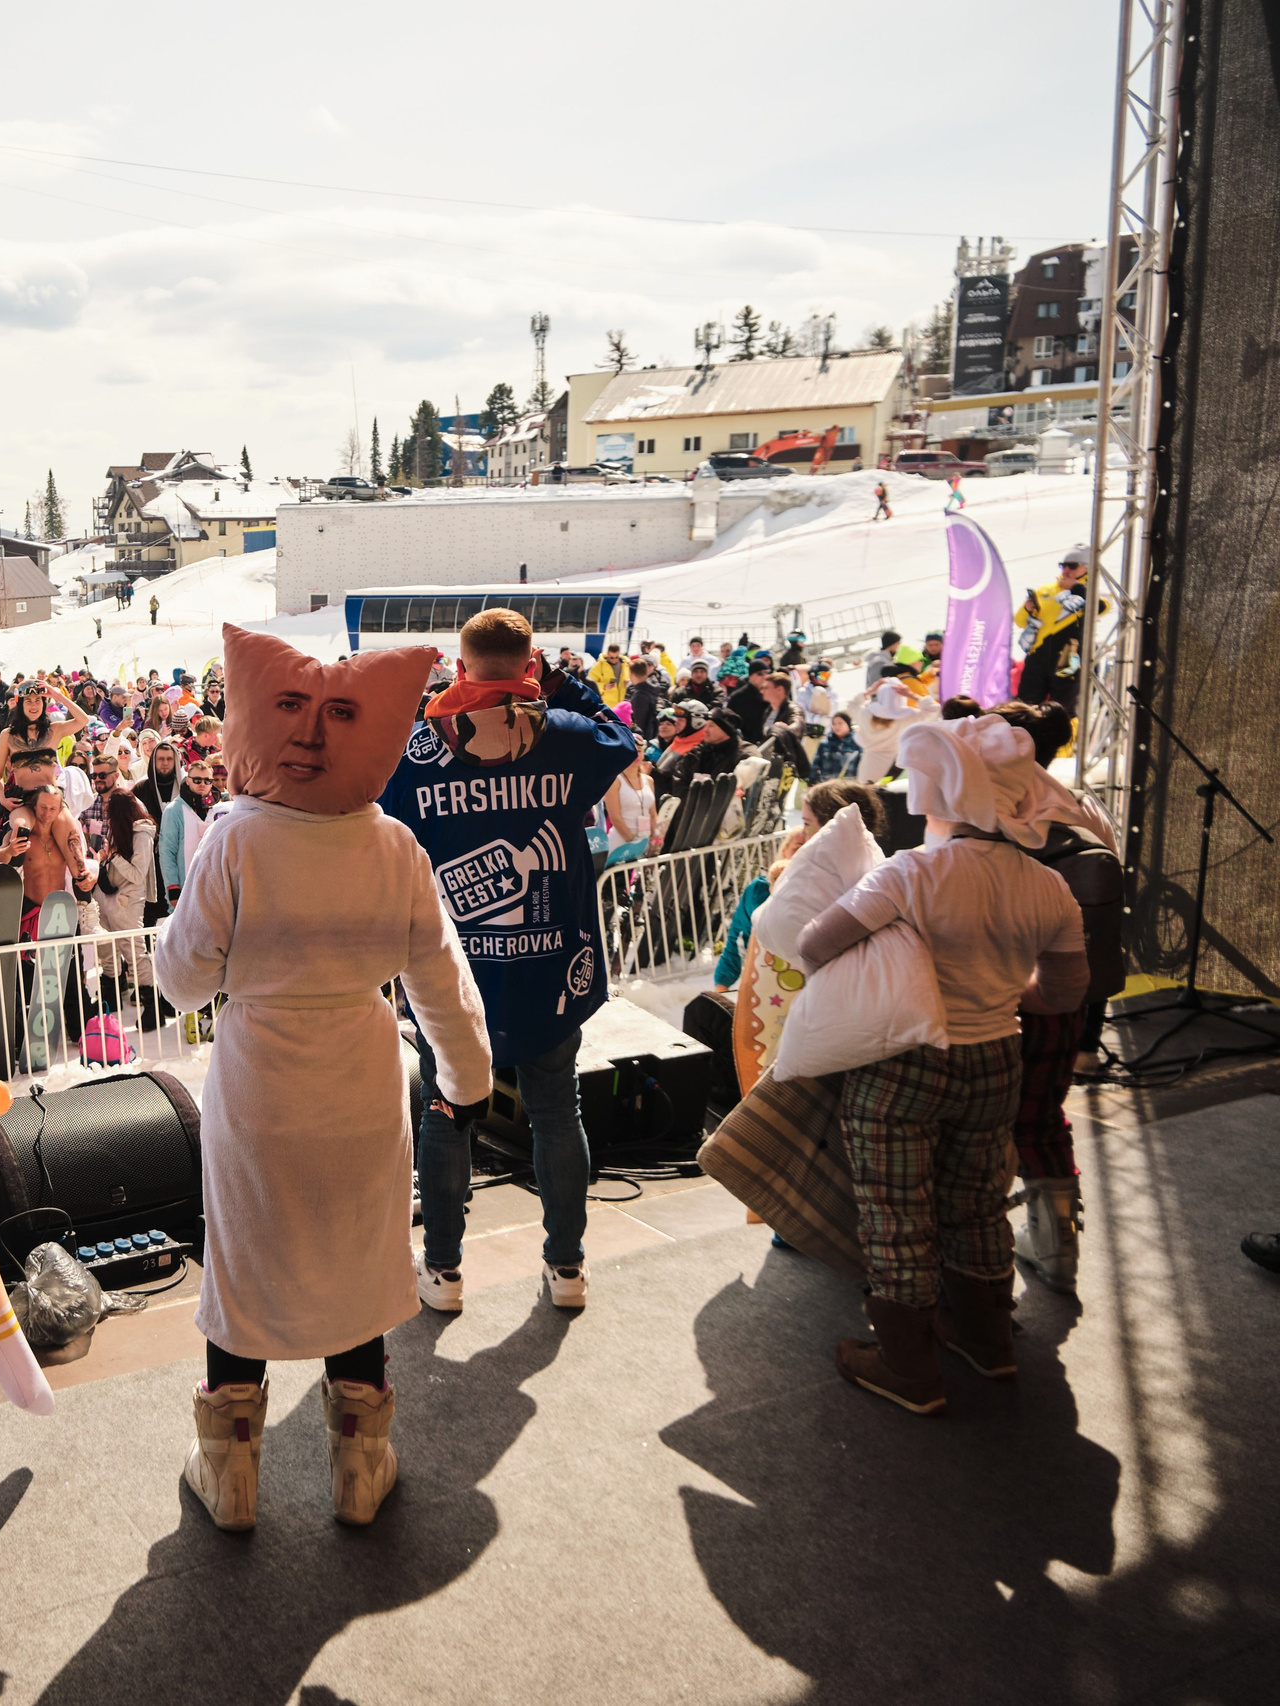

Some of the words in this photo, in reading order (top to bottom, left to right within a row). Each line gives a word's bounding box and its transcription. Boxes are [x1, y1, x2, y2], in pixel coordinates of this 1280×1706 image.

[416, 773, 574, 820] PERSHIKOV
[443, 848, 510, 892] GRELKA
[453, 878, 498, 913] FEST
[532, 890, 540, 904] RIDE
[542, 875, 550, 903] FESTIVAL
[532, 911, 540, 923] SUN
[542, 903, 550, 922] MUSIC
[459, 931, 563, 956] ECHEROVKA
[24, 903, 71, 1069] ARBOR
[142, 1258, 156, 1270] 23
